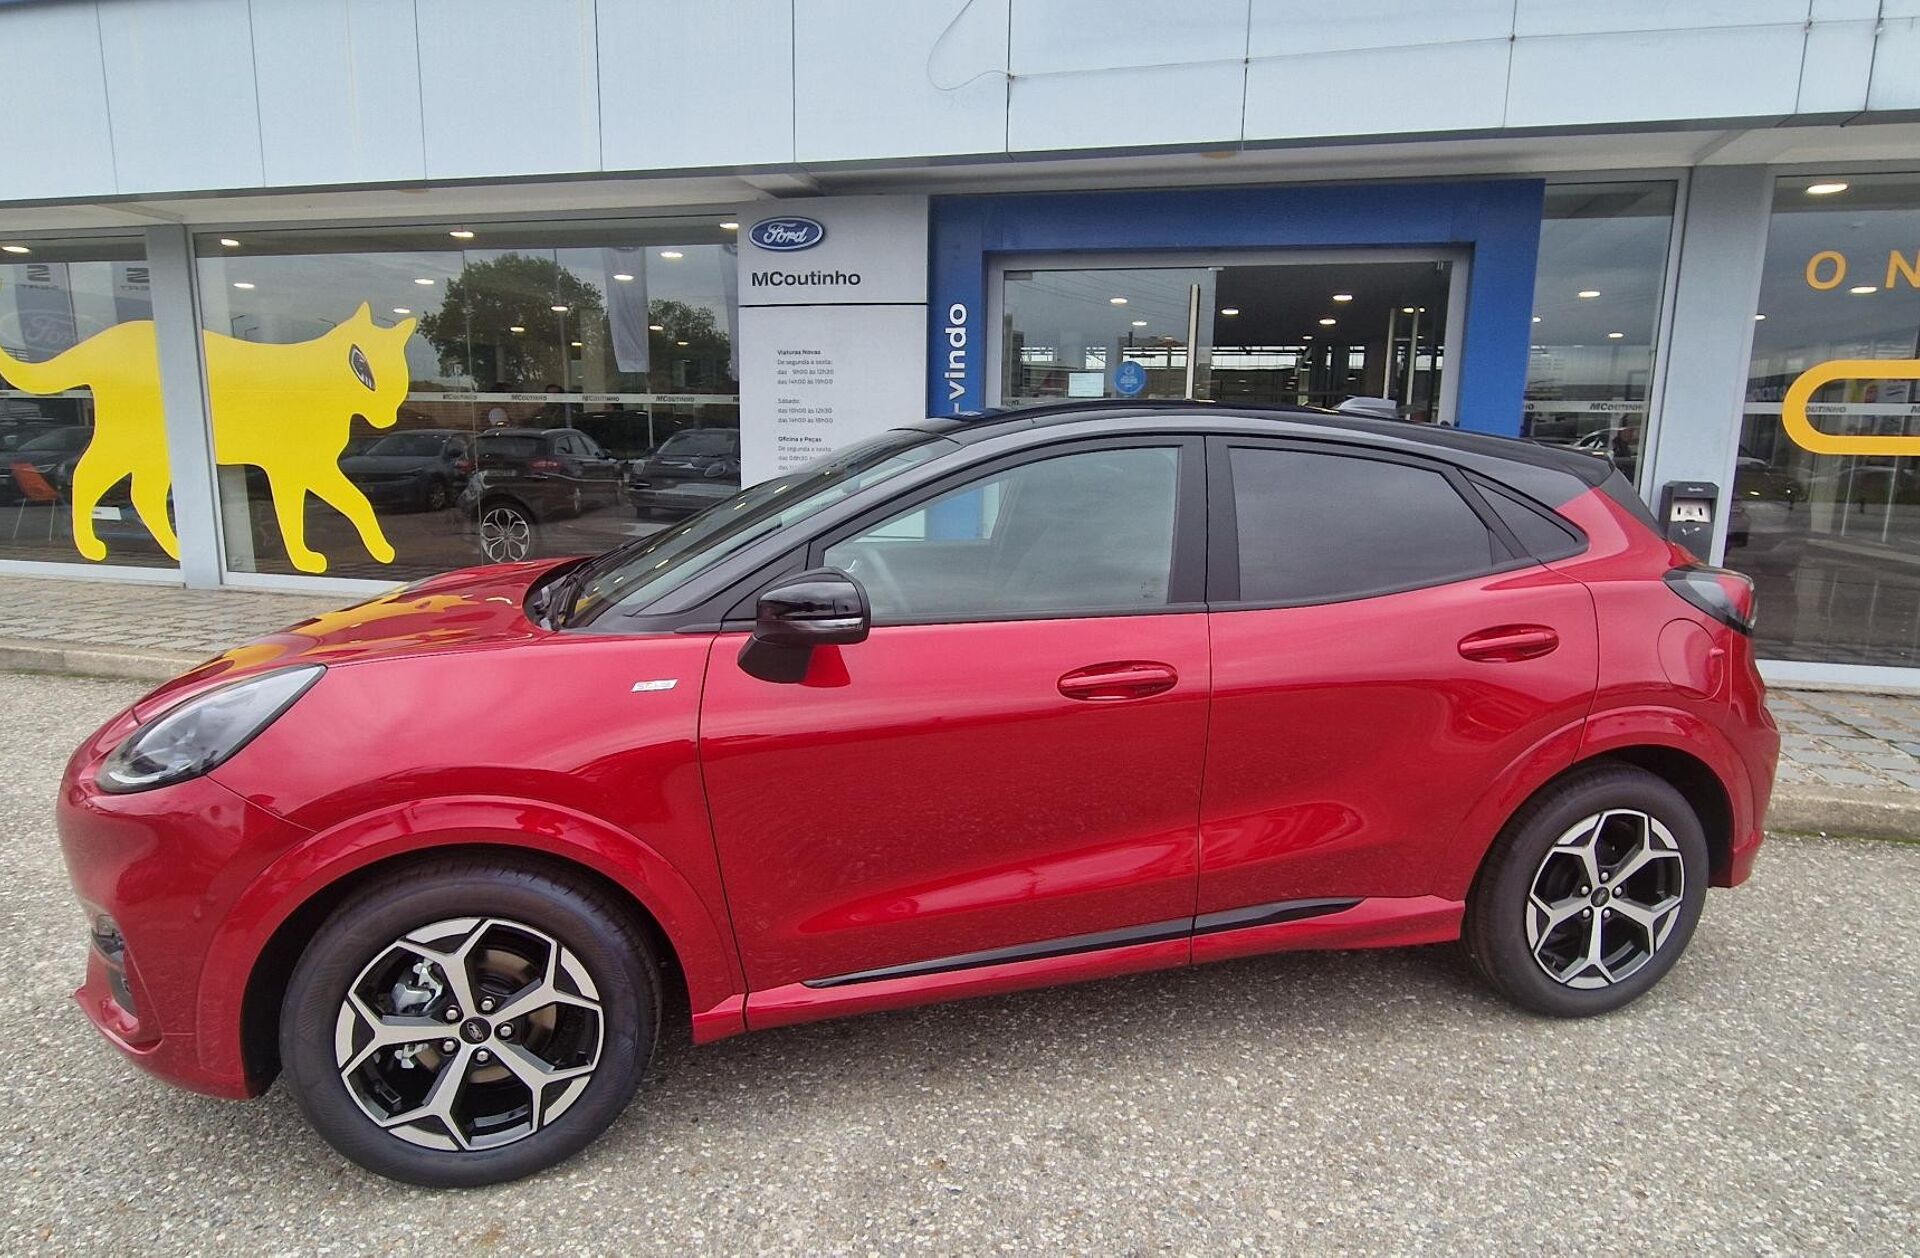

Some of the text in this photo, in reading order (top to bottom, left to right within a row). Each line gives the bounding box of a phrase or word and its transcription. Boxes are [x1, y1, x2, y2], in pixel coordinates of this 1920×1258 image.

[763, 222, 808, 244] Ford
[751, 271, 861, 287] MCoutinho
[786, 359, 810, 367] segunda
